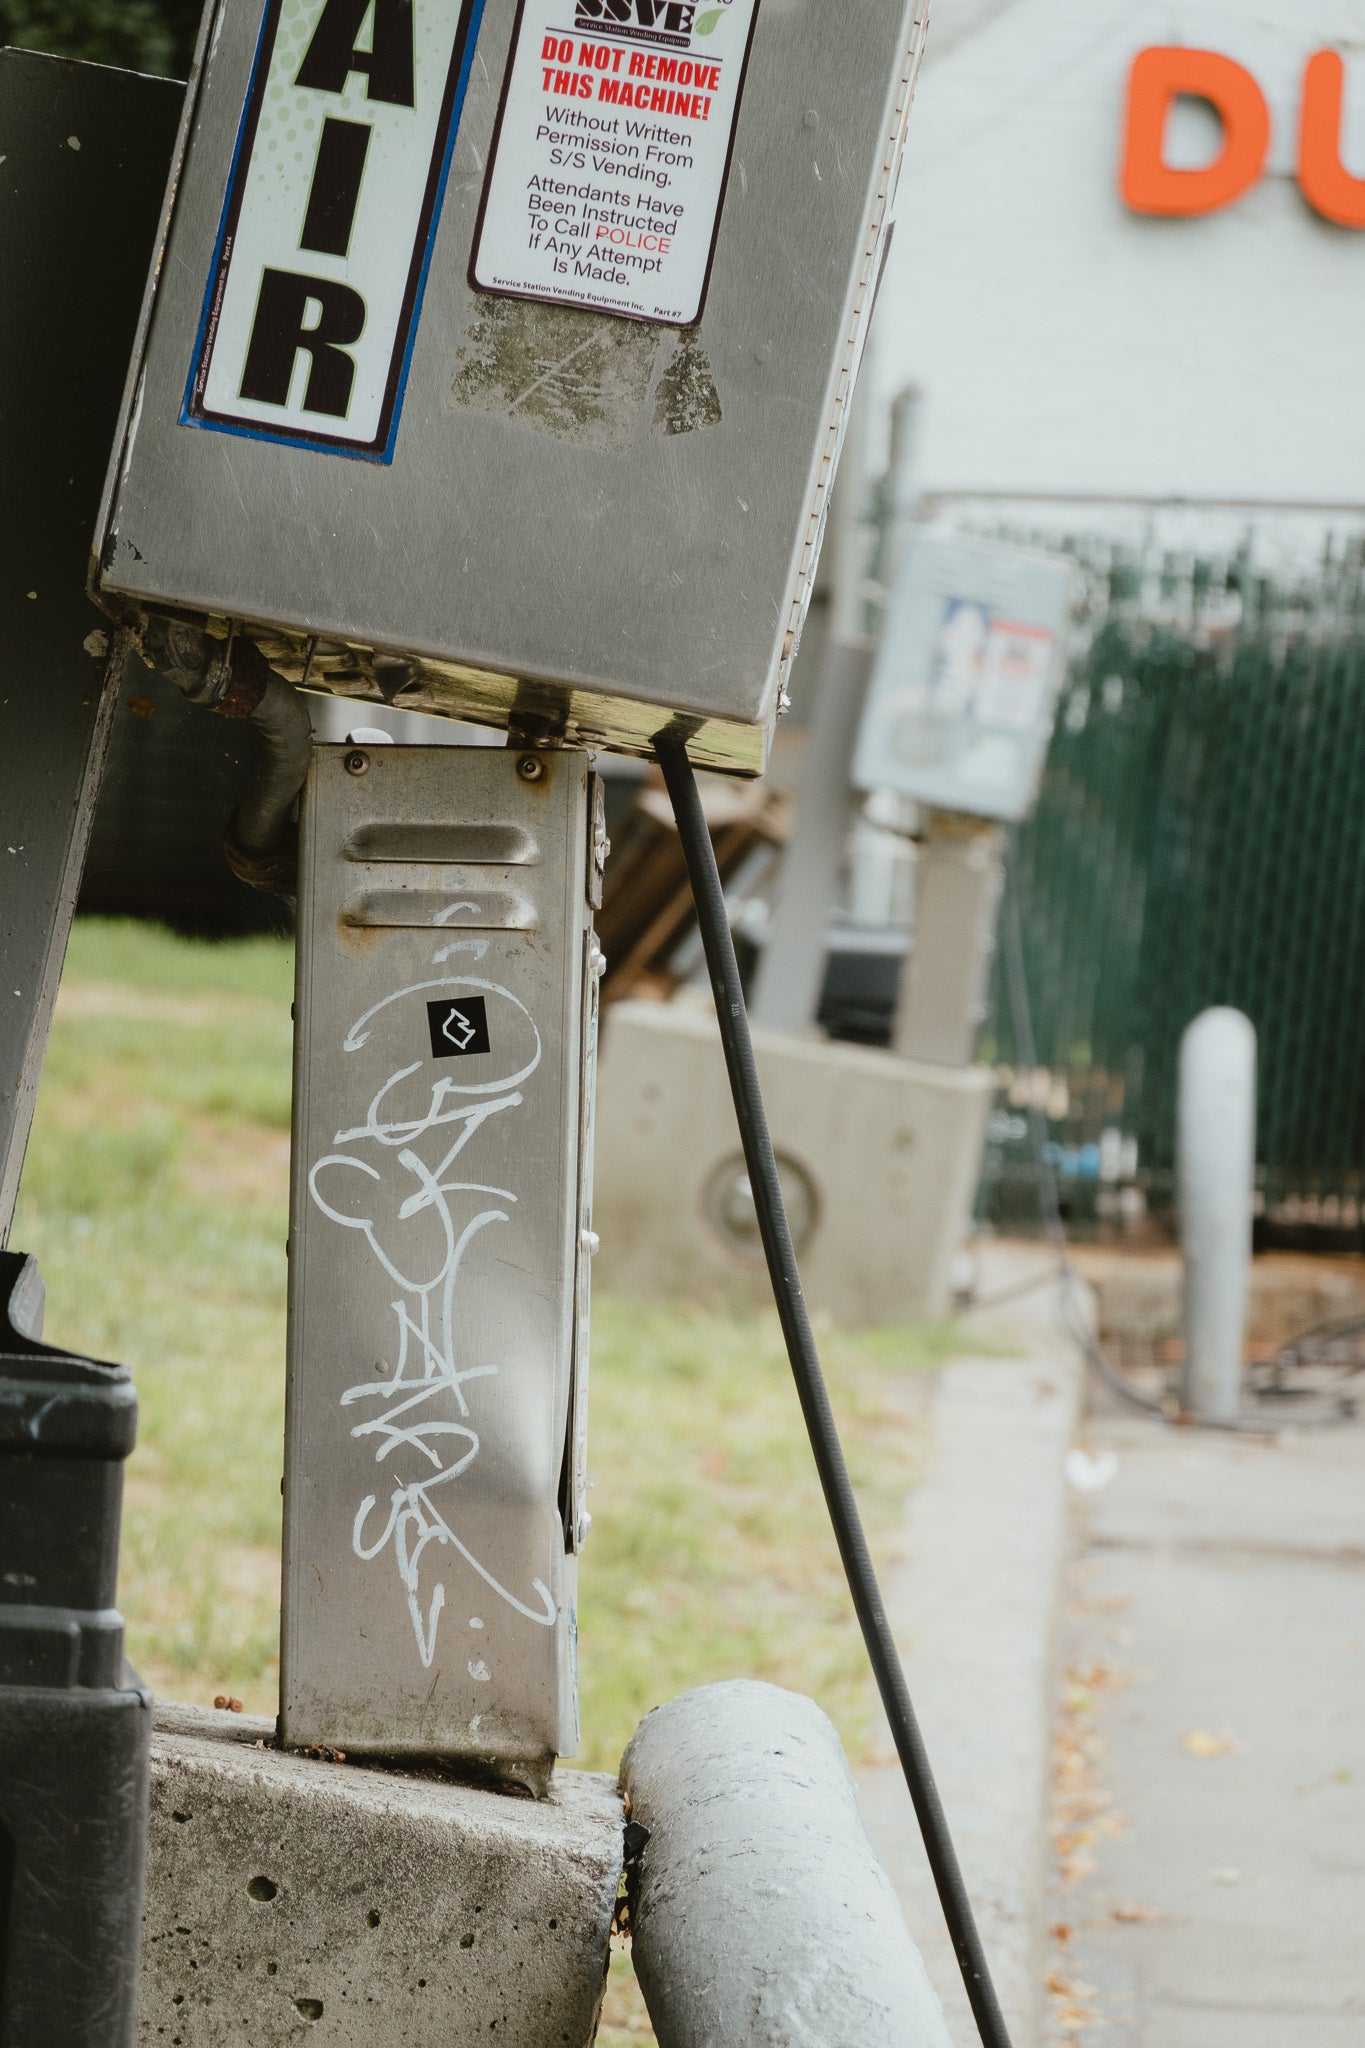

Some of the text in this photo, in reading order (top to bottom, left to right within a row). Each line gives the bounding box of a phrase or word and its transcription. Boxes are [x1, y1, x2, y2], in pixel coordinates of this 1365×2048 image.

[579, 20, 604, 30] Service
[604, 24, 629, 36] Station
[629, 28, 658, 41] Vending
[541, 36, 721, 91] DO NOT REMOVE
[542, 67, 712, 121] THIS MACHINE!
[536, 125, 693, 168] Permission From
[546, 105, 692, 147] Without Written
[550, 148, 672, 188] S/S Vending.
[239, 0, 416, 419] AIR
[526, 174, 684, 217] Attendants Have
[528, 193, 678, 236] Been Instructed
[528, 213, 672, 254] To Call POLICE
[528, 233, 663, 274] If Any Attempt
[553, 257, 630, 286] Is Made.
[211, 280, 225, 316] Equipment
[492, 276, 682, 319] Service Station Vending Equipment Inc. Part #7
[207, 316, 218, 344] Vending
[201, 344, 212, 369] Station
[197, 368, 206, 393] Service
